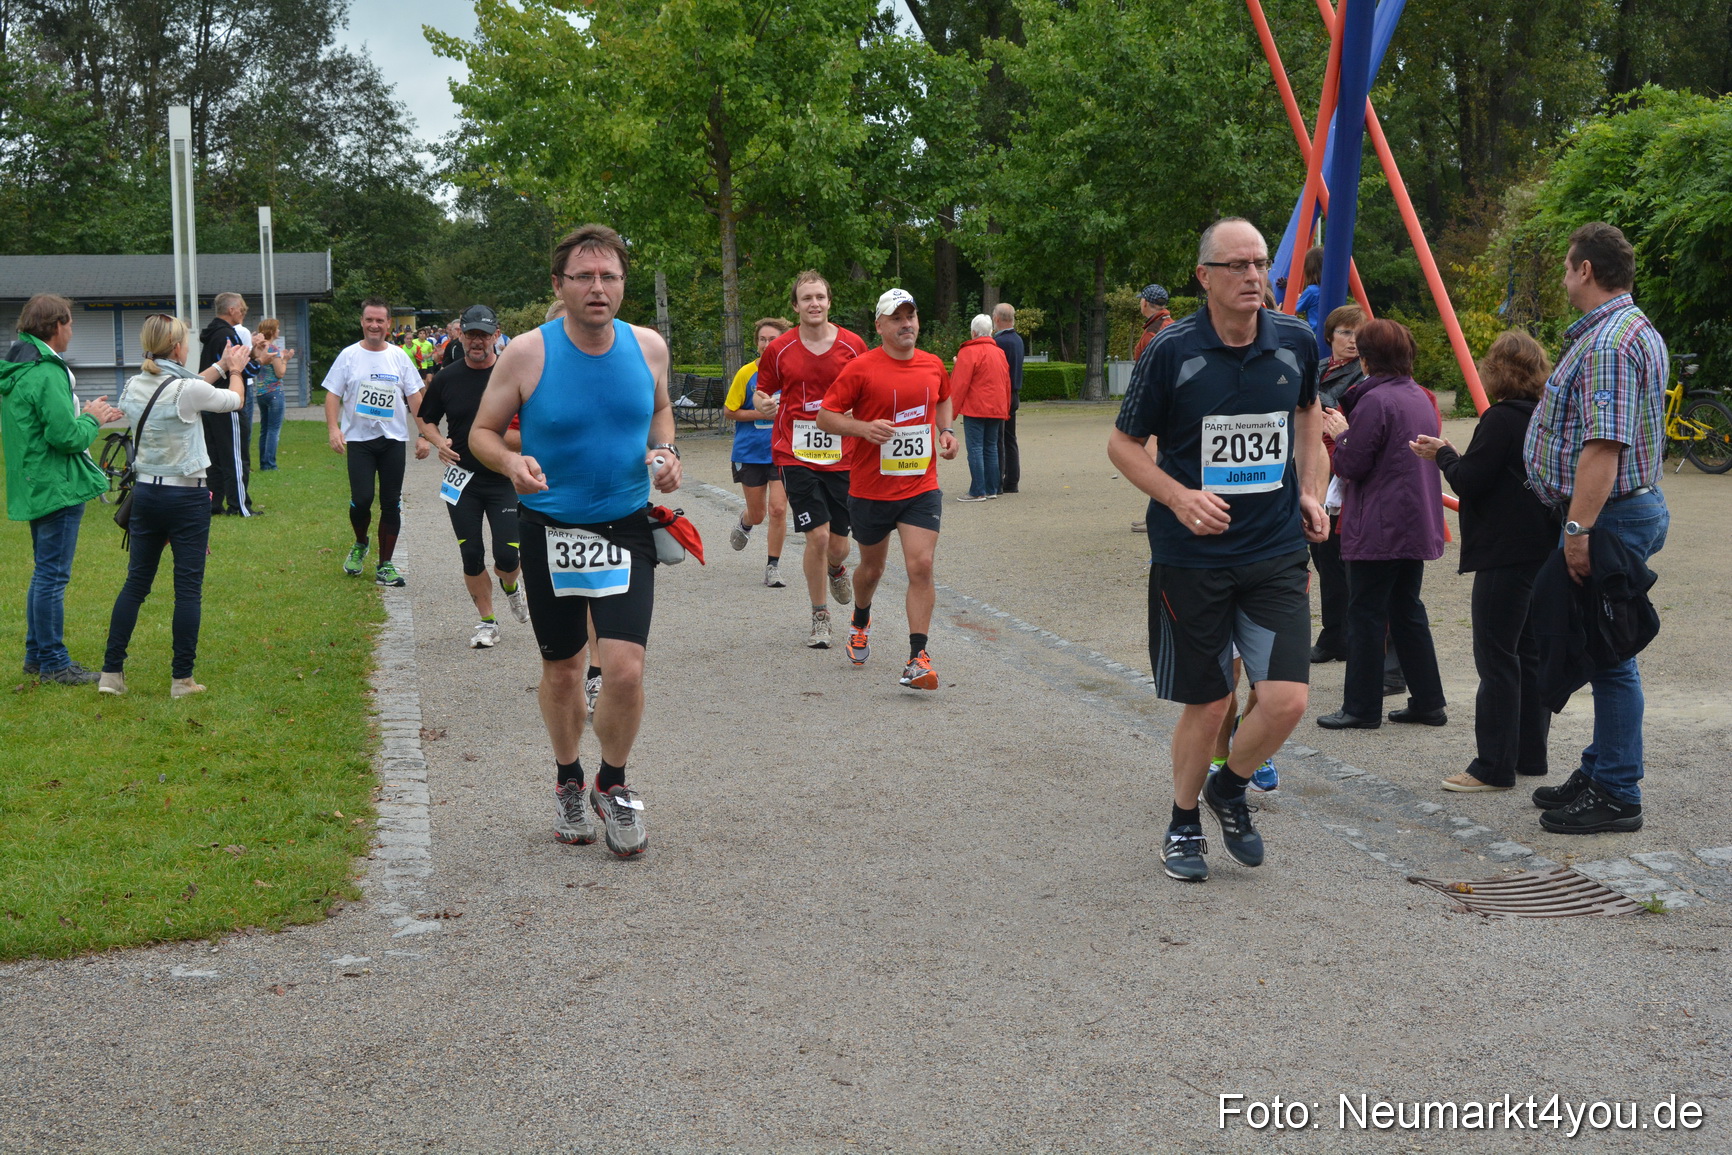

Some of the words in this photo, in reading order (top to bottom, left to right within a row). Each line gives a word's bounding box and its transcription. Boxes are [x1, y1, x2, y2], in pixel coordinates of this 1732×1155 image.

[361, 390, 394, 408] 2652
[1204, 423, 1233, 431] PARTL
[1235, 421, 1275, 430] Neumarkt
[804, 431, 833, 448] 155
[892, 437, 924, 457] 253
[1211, 432, 1282, 463] 2034
[898, 461, 919, 469] Mario
[1226, 471, 1266, 483] Johann
[798, 511, 812, 526] 53
[547, 531, 575, 539] PARTL
[555, 541, 622, 569] 3320
